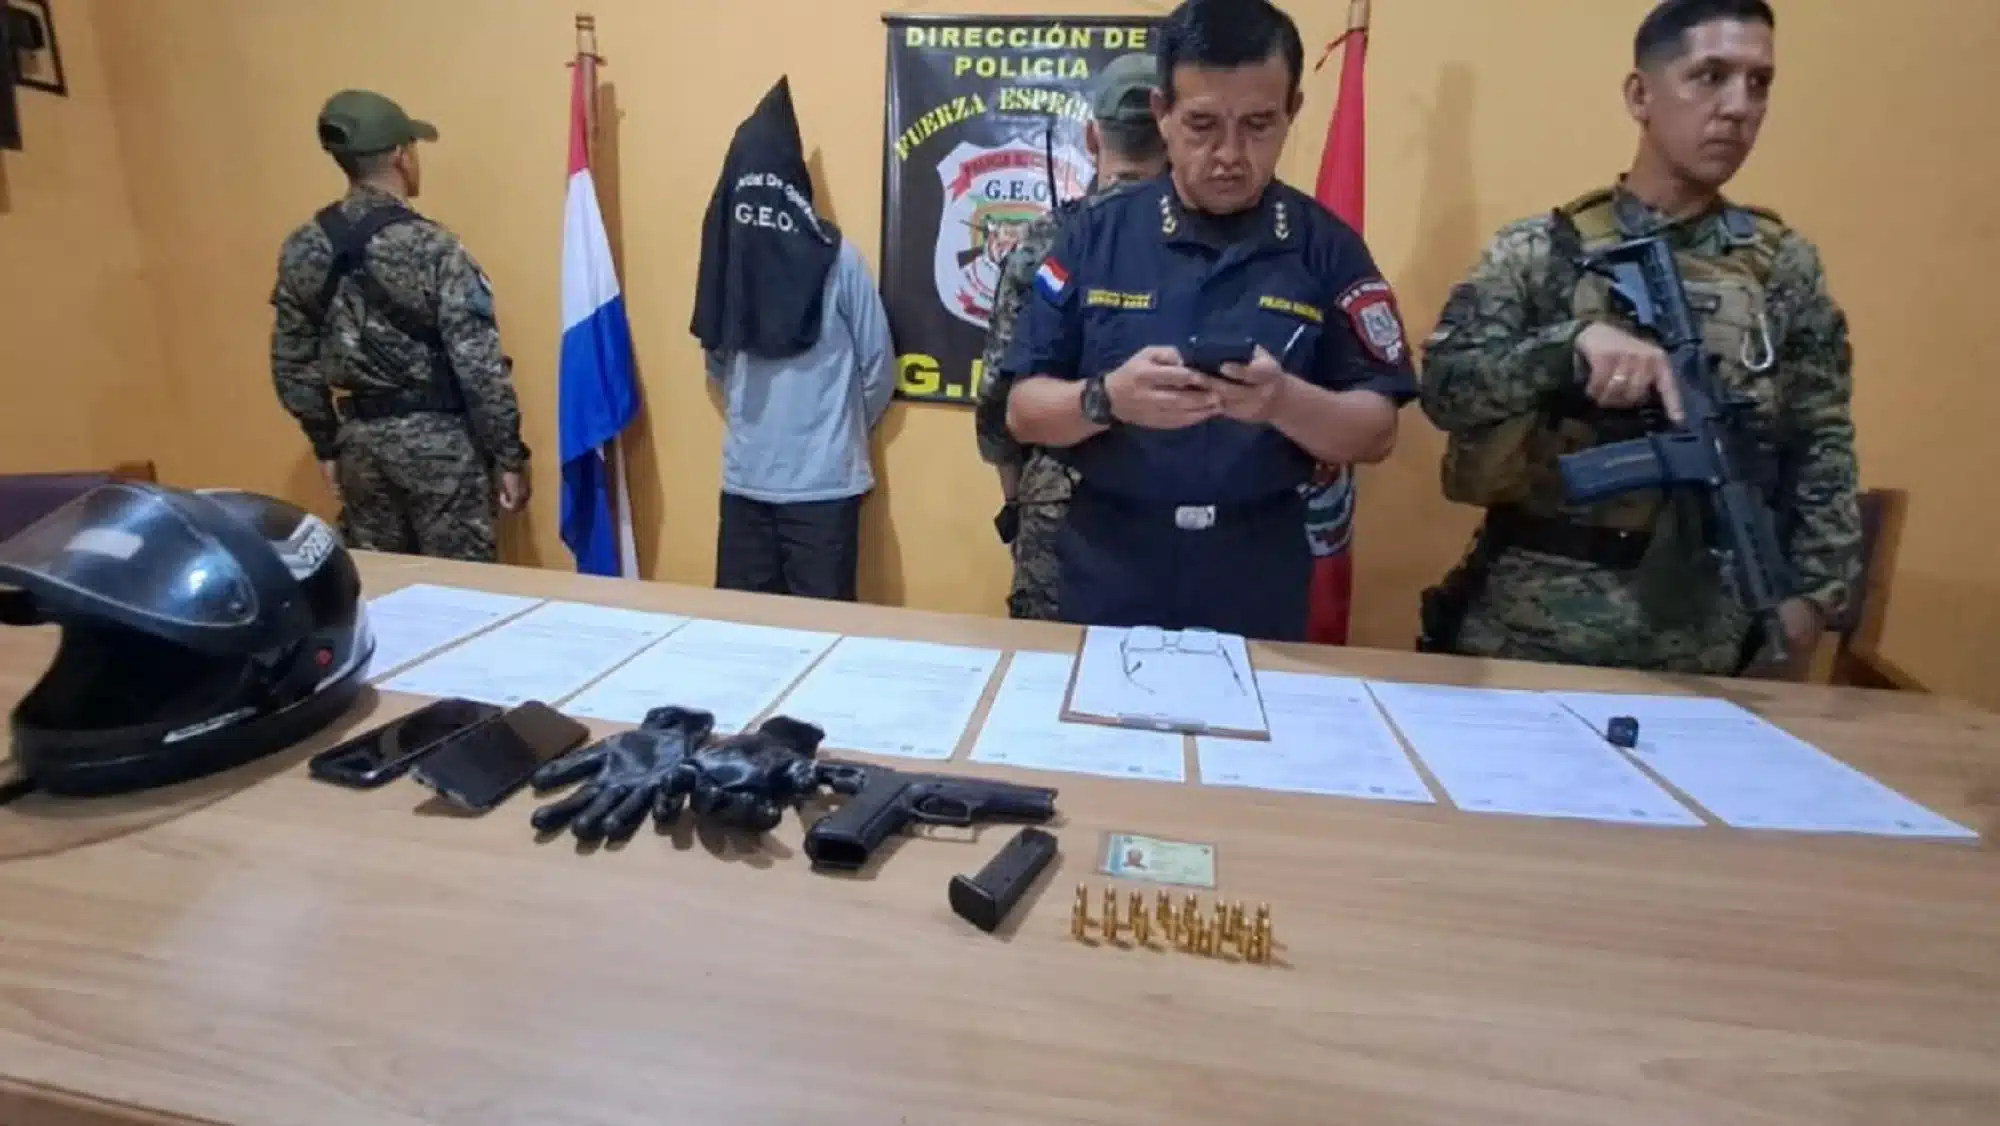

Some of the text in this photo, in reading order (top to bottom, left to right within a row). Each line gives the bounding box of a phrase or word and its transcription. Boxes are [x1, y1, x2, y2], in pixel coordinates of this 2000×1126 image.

[906, 23, 1147, 48] DIRECCIÓN DE
[954, 56, 1090, 79] POLICIA
[894, 92, 988, 162] FUERZA
